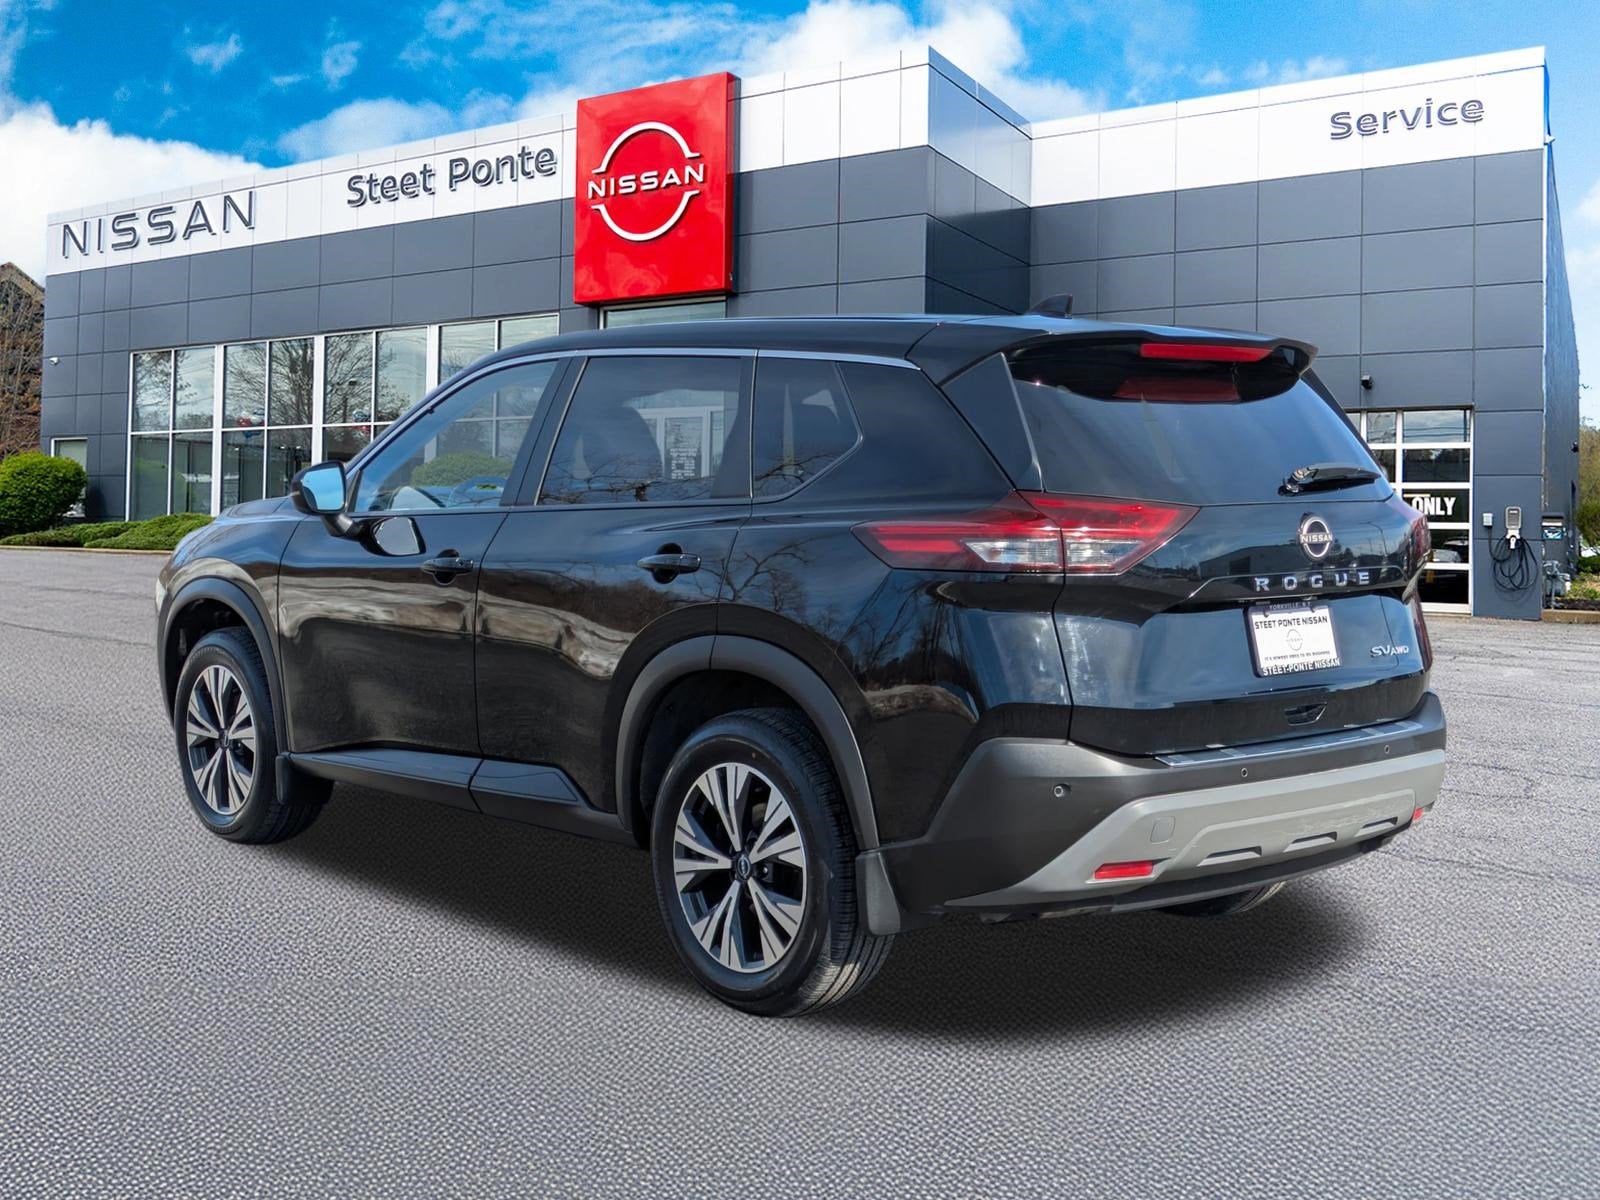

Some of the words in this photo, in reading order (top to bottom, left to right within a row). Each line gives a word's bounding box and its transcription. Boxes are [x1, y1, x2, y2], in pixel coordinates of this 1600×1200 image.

[1330, 97, 1484, 140] Service
[347, 163, 436, 207] Steet
[449, 145, 558, 191] Ponte
[587, 163, 705, 199] NISSAN
[62, 191, 256, 259] NISSAN
[1411, 496, 1456, 515] ONLY
[1300, 534, 1333, 543] NISSAN
[1254, 571, 1370, 592] ROGUE
[1255, 620, 1276, 629] STEET
[1278, 618, 1301, 627] PONTE
[1302, 616, 1328, 625] NISSAN
[1371, 645, 1390, 656] SV
[1315, 658, 1341, 669] NISSAN
